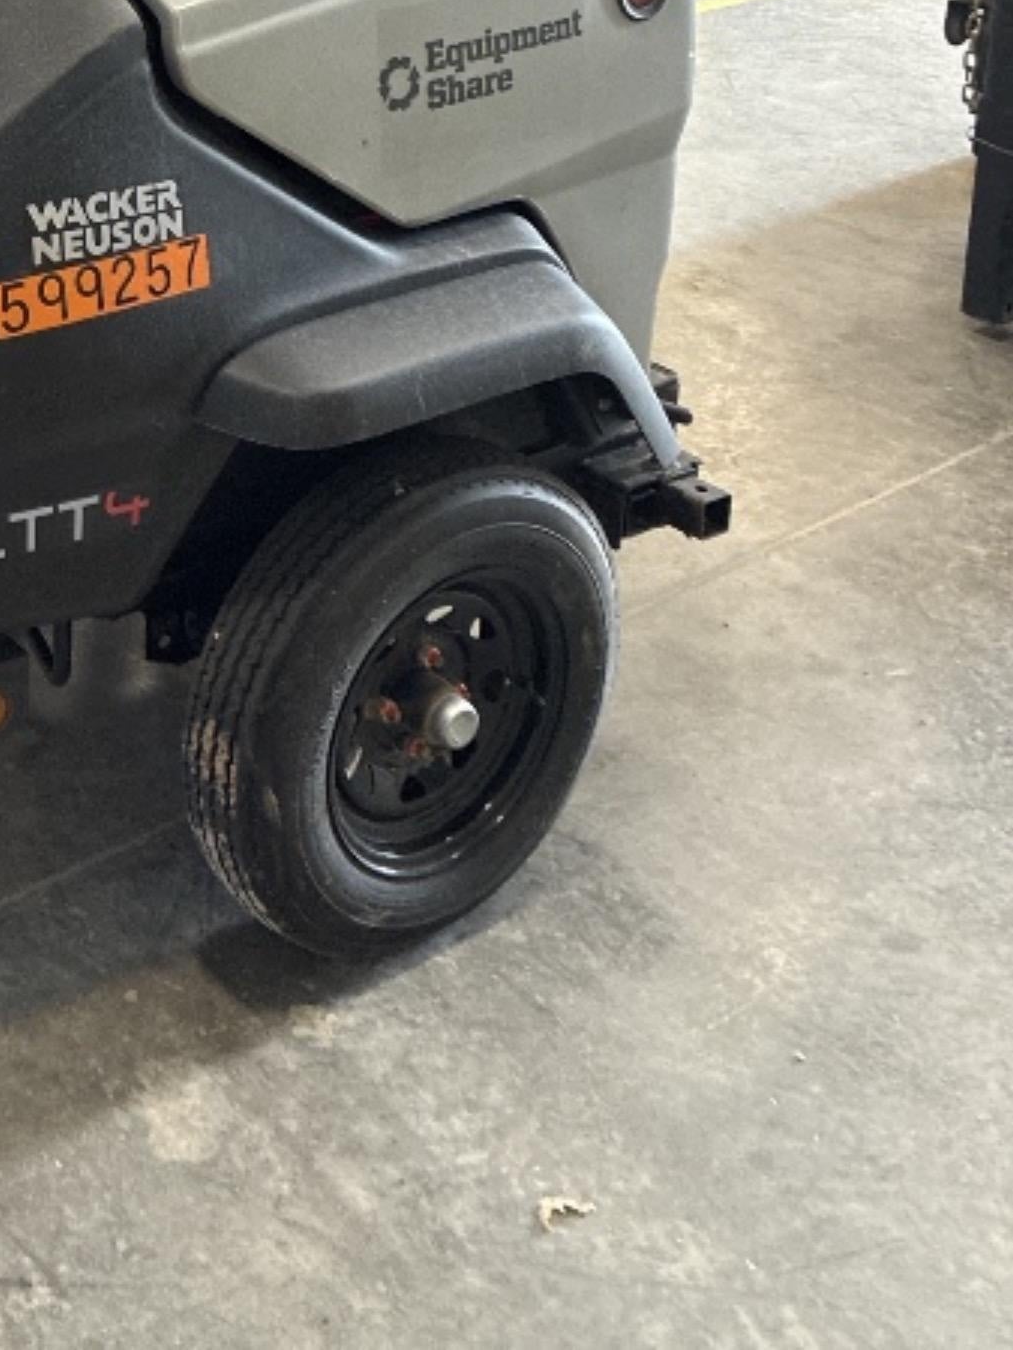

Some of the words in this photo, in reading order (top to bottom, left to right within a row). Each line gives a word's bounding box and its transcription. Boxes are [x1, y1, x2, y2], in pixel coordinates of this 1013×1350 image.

[424, 9, 582, 72] Equipment
[426, 68, 513, 110] Share
[25, 179, 182, 232] WACKER
[31, 209, 184, 265] NEUSON
[1, 238, 200, 333] 599257
